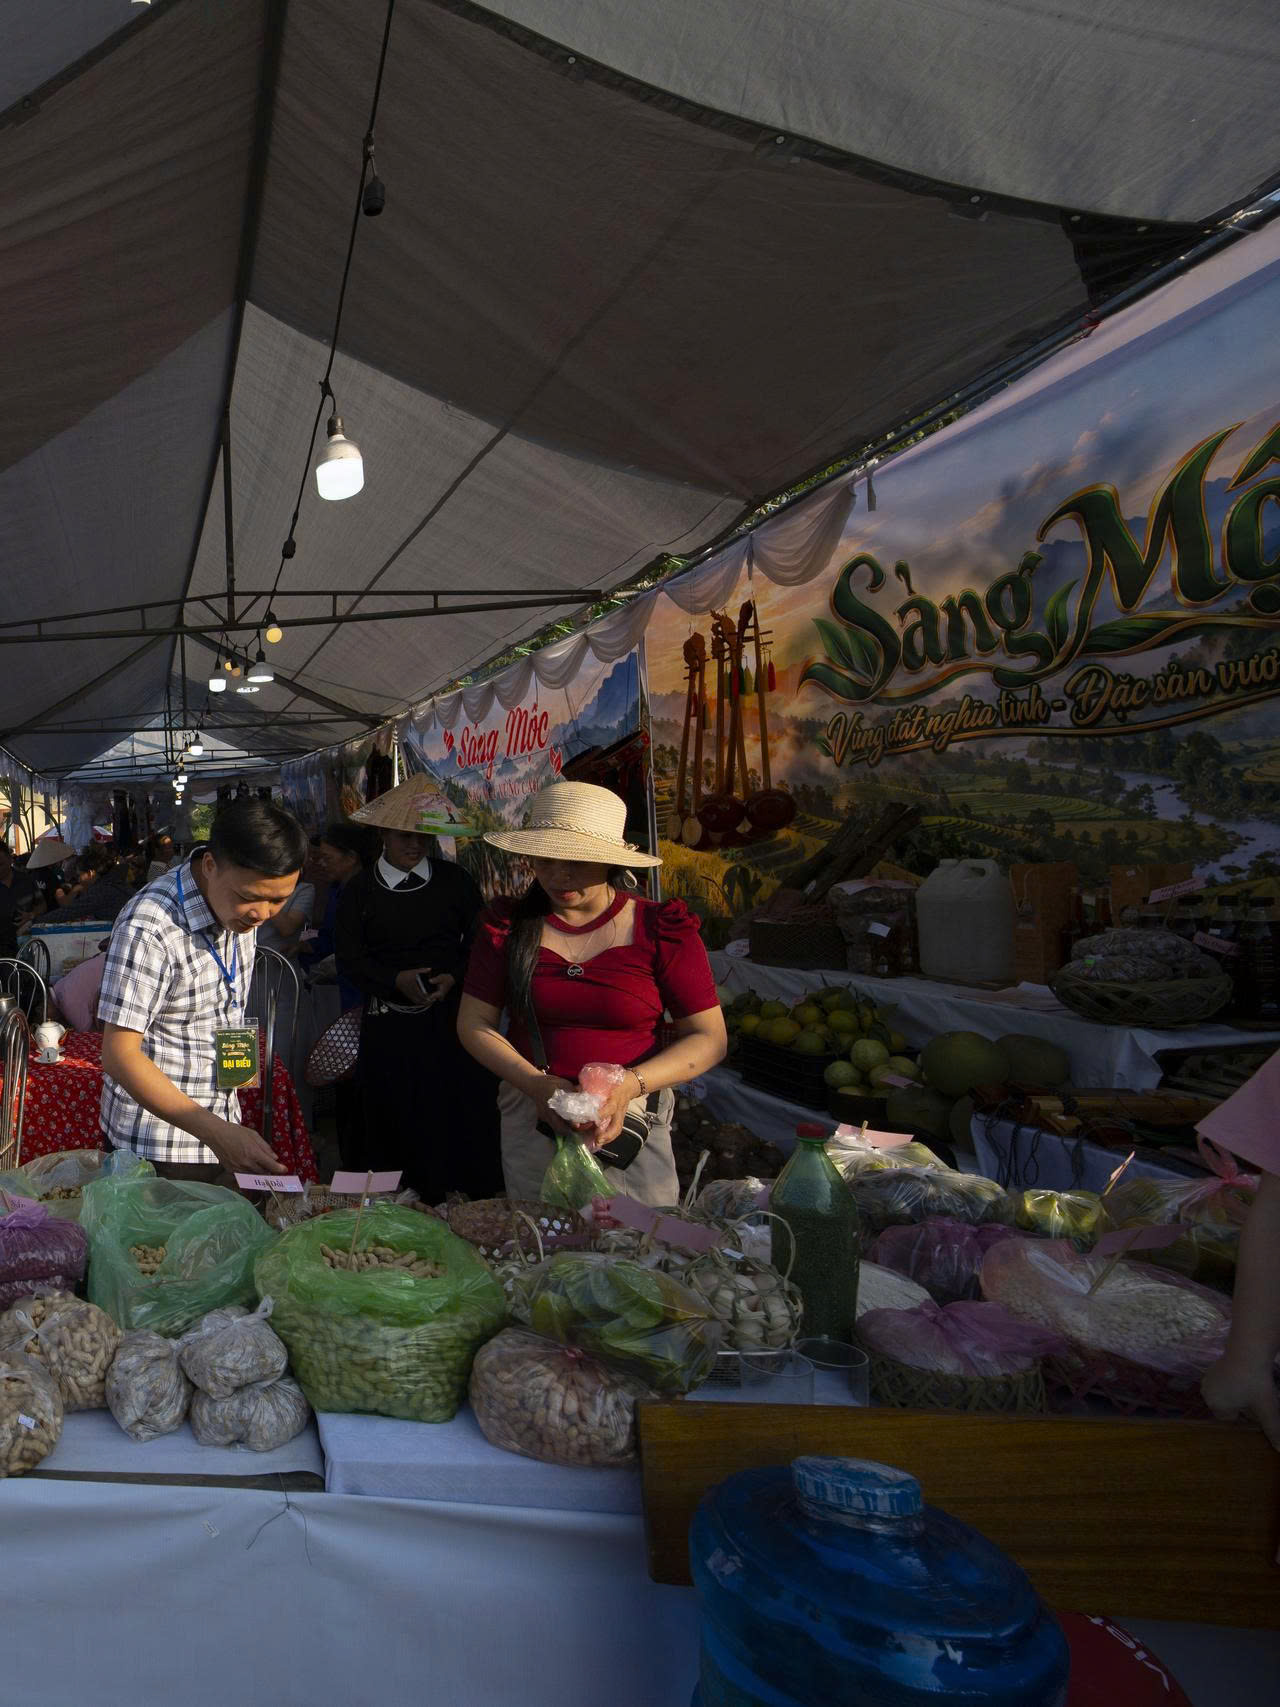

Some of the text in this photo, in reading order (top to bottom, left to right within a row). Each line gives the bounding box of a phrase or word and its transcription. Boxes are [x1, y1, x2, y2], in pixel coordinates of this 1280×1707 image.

[505, 703, 549, 762] Mộc
[826, 711, 886, 767] Vùng
[925, 694, 999, 753] nghĩa
[999, 683, 1050, 724] tình
[1064, 664, 1150, 726] Đặc
[1152, 662, 1214, 703] sản
